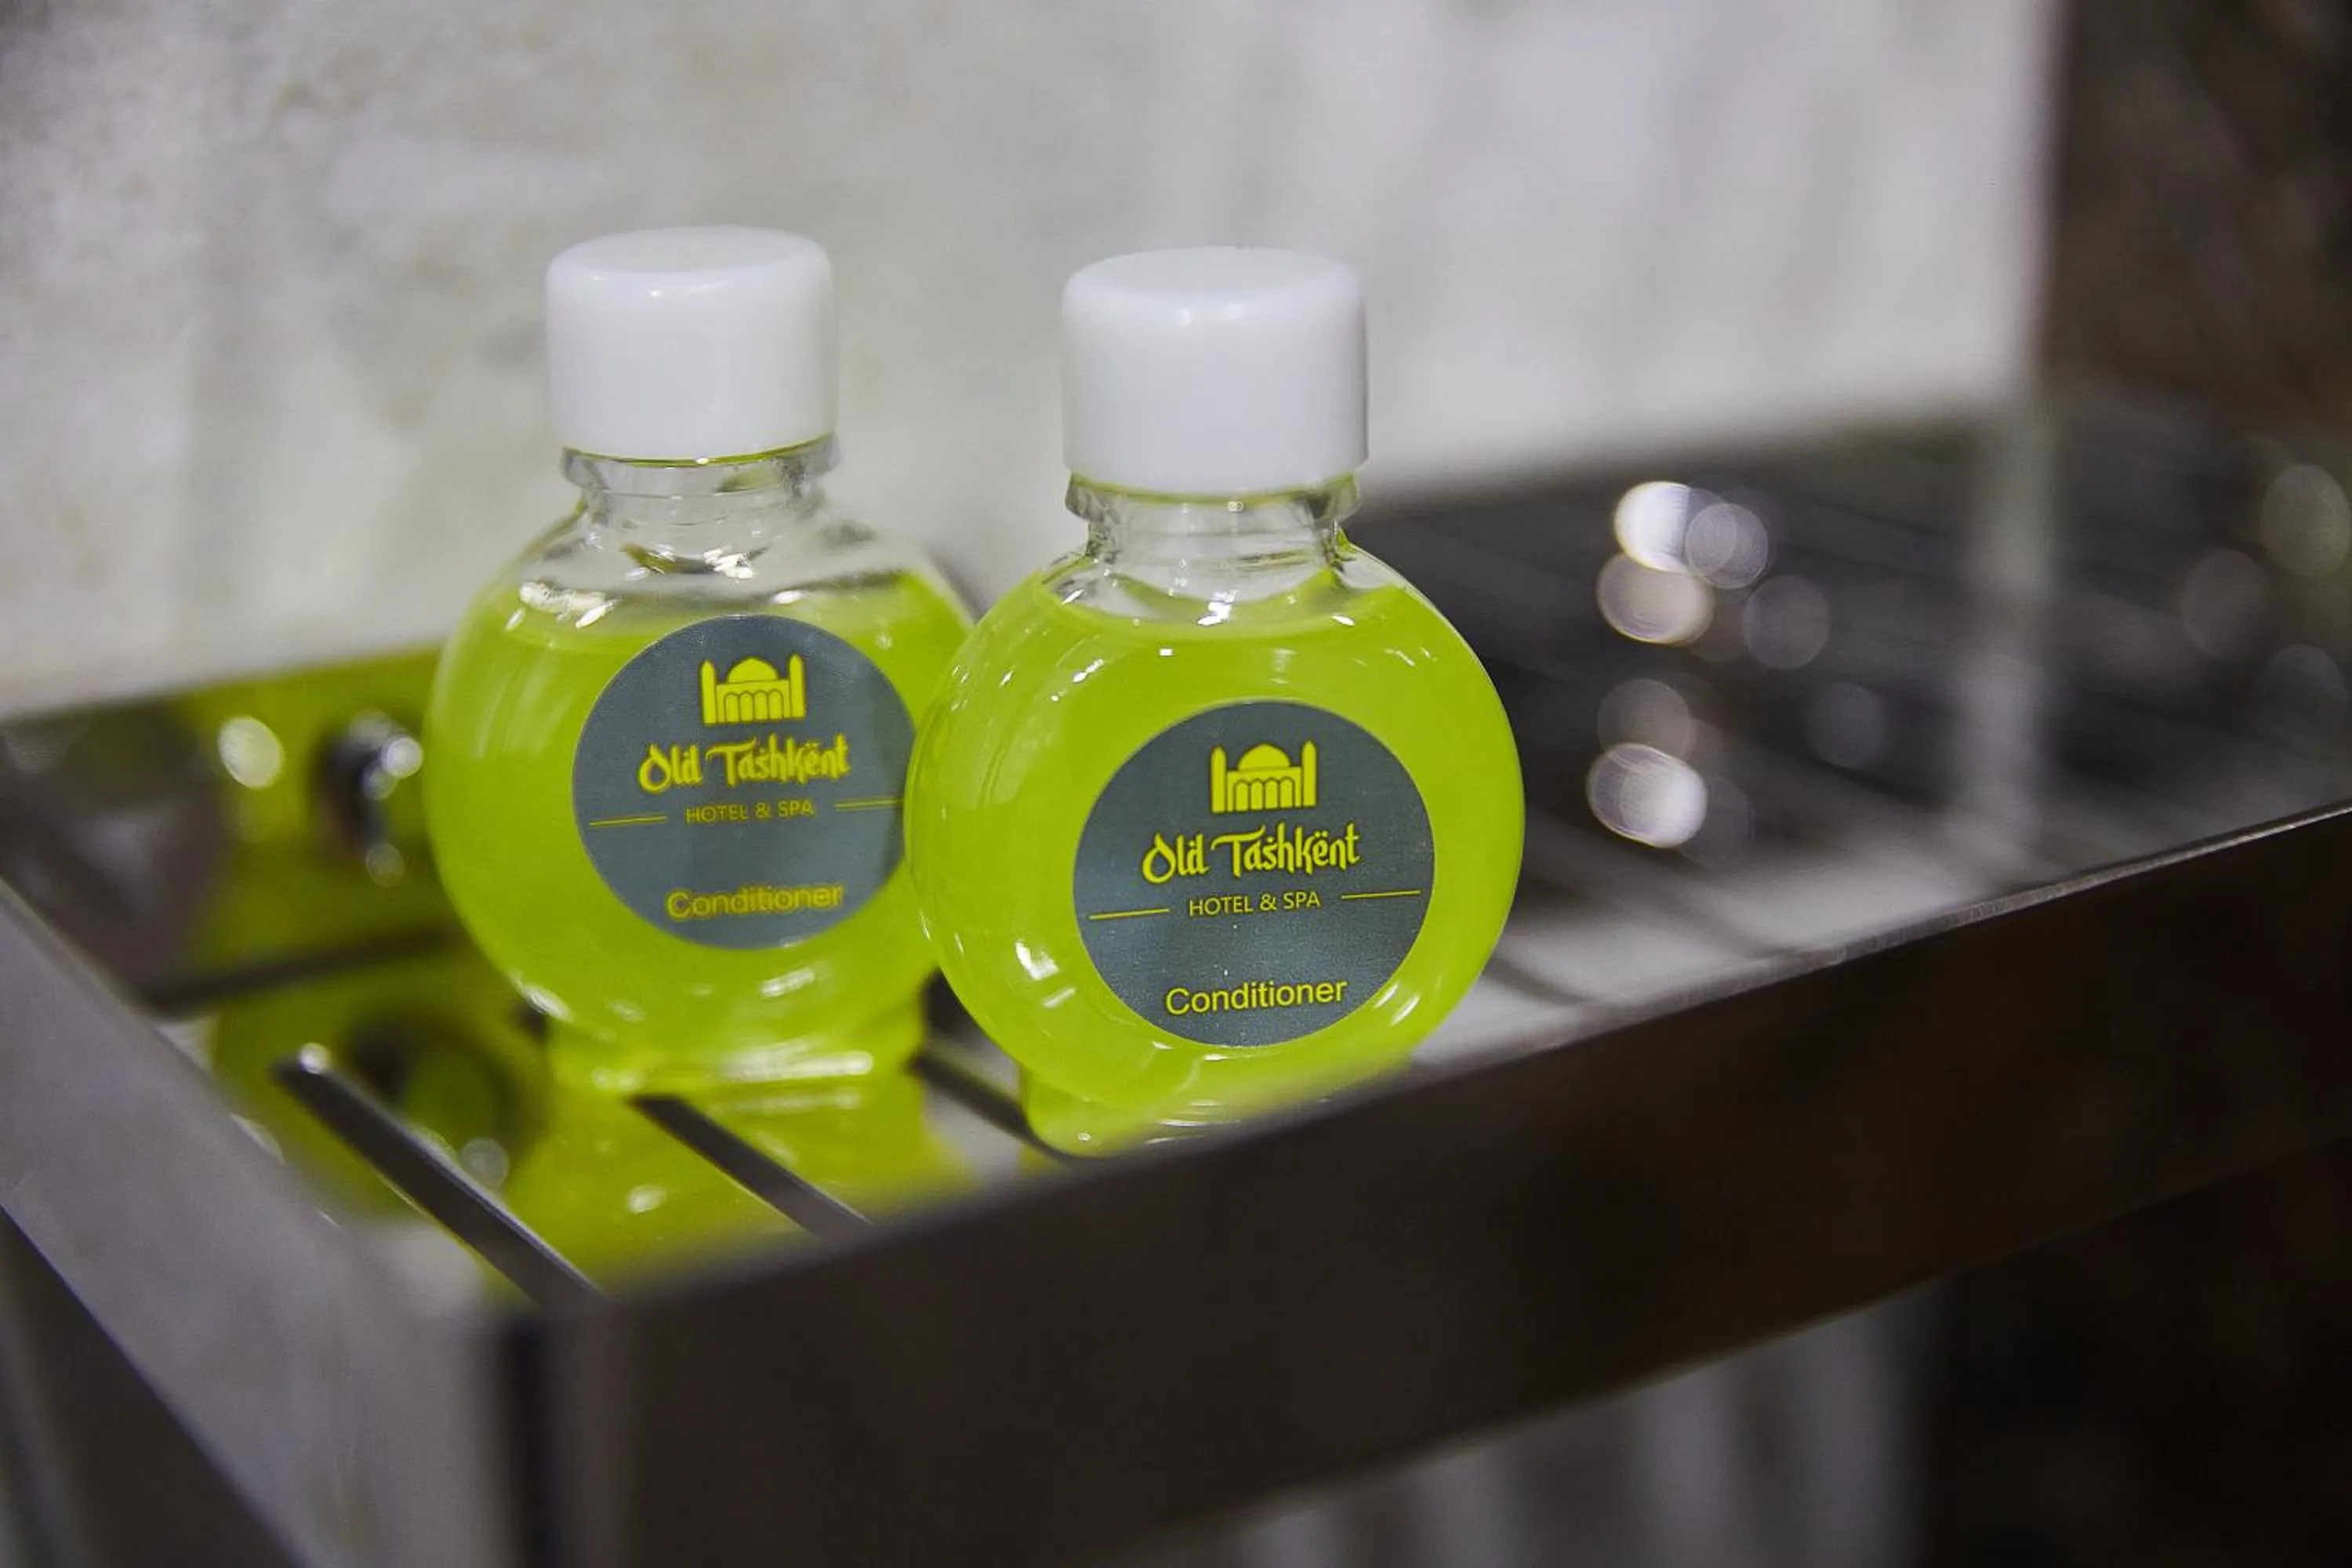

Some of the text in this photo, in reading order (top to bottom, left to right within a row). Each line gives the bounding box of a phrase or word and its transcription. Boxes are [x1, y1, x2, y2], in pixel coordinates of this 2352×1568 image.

[637, 743, 702, 794] Old
[685, 798, 815, 823] HOTEL & SPA
[1142, 833, 1210, 884] Old
[666, 884, 844, 920] Conditioner
[1189, 891, 1322, 916] HOTEL & SPA
[1165, 980, 1348, 1016] Conditioner
